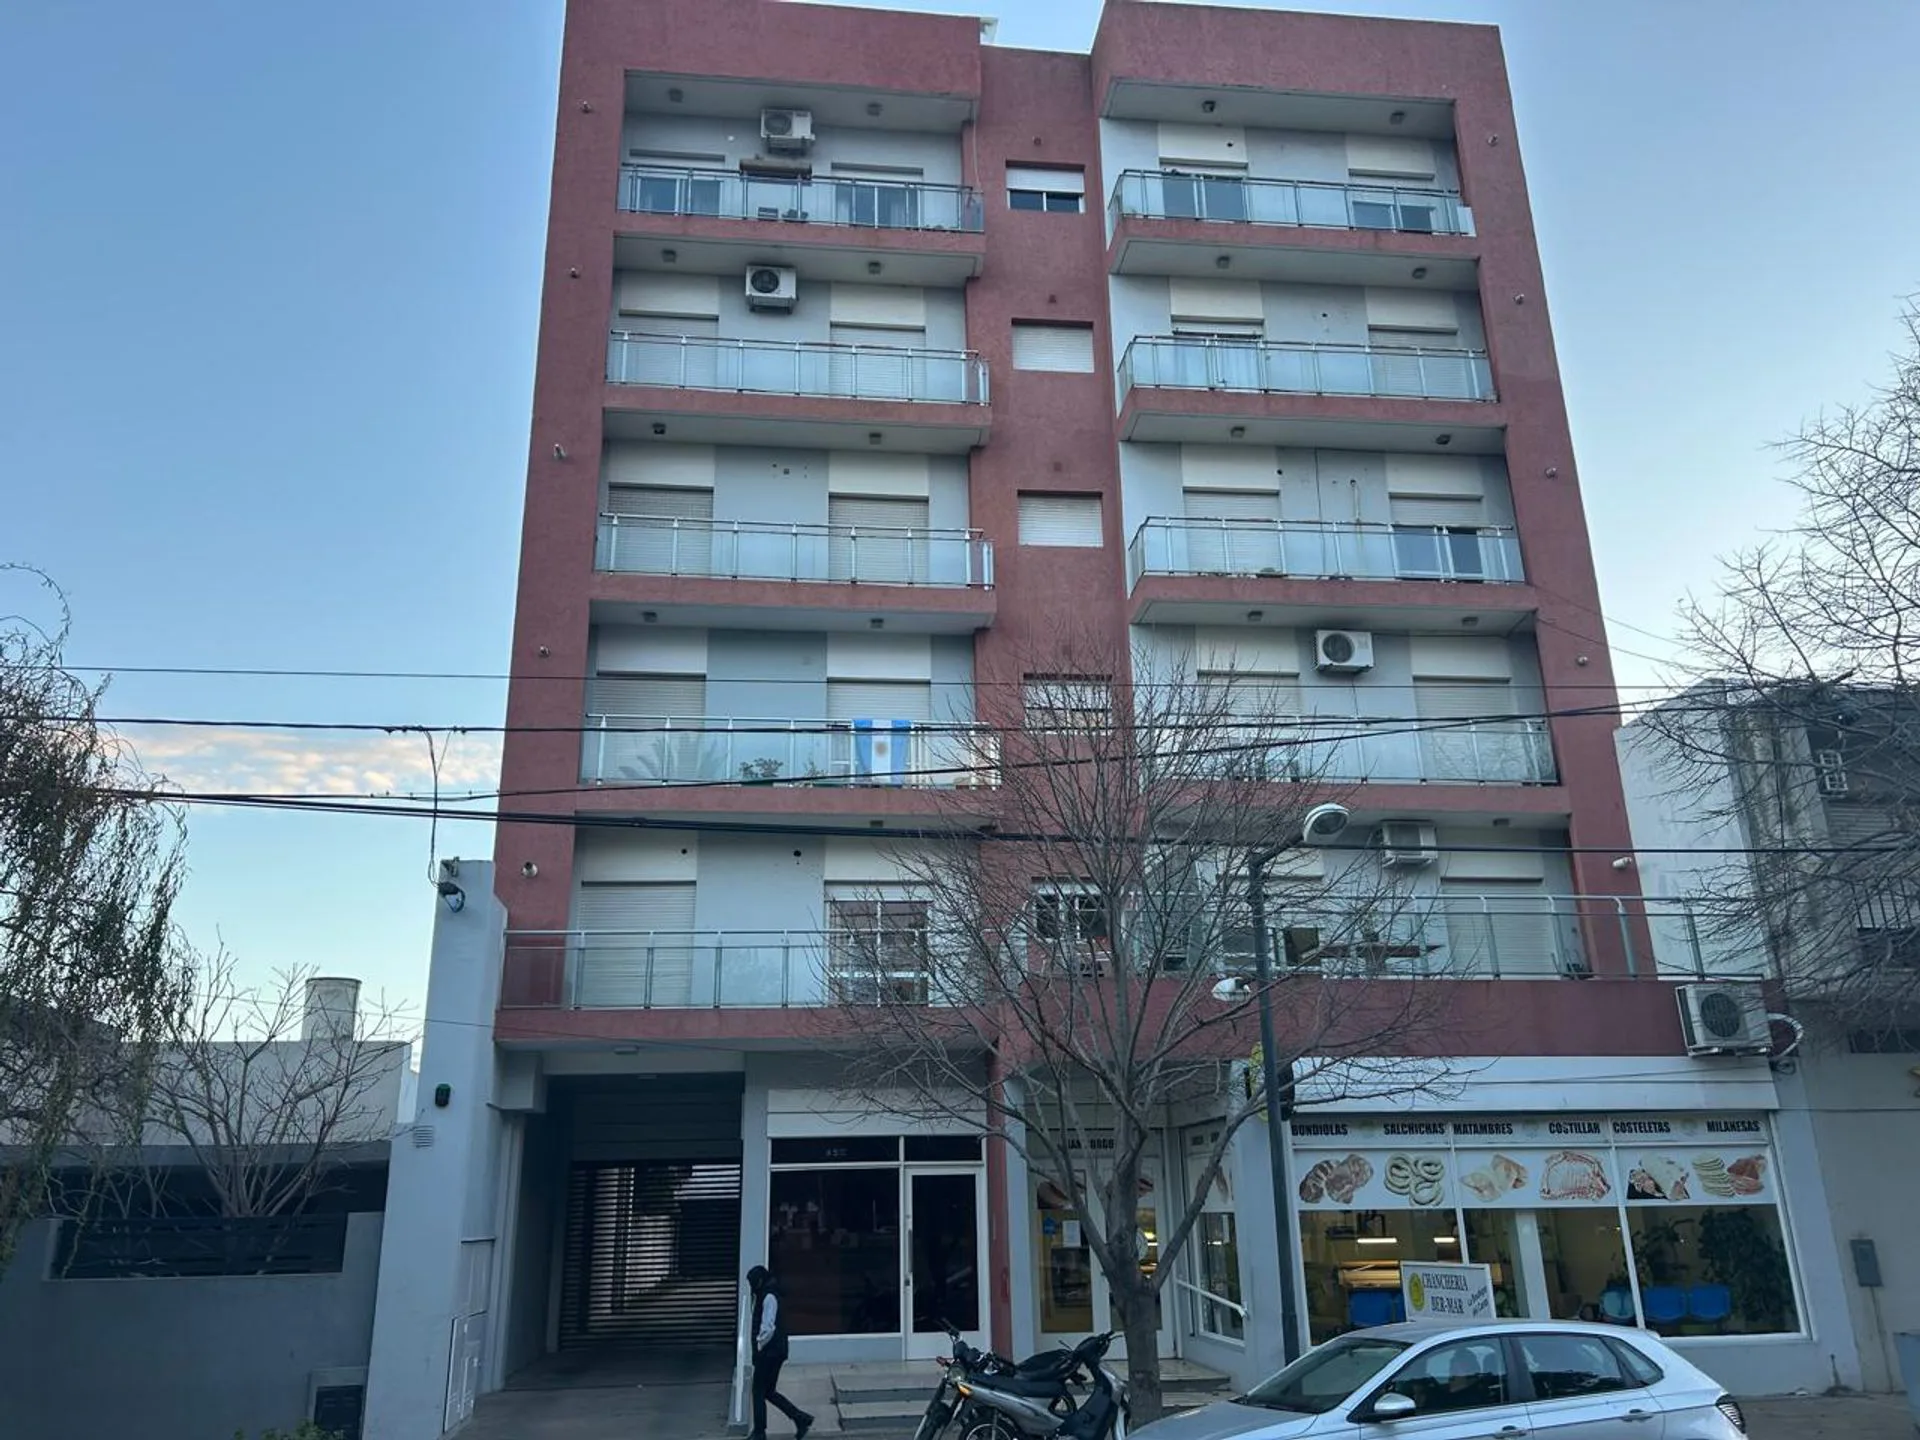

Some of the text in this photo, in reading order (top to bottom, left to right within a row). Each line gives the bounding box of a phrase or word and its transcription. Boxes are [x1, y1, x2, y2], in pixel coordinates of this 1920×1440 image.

[1383, 1122, 1446, 1136] SALCHICHAS
[1453, 1120, 1601, 1136] MATAMBRES COSTILLAR
[1612, 1120, 1761, 1134] COSTELETAS MILANESAS
